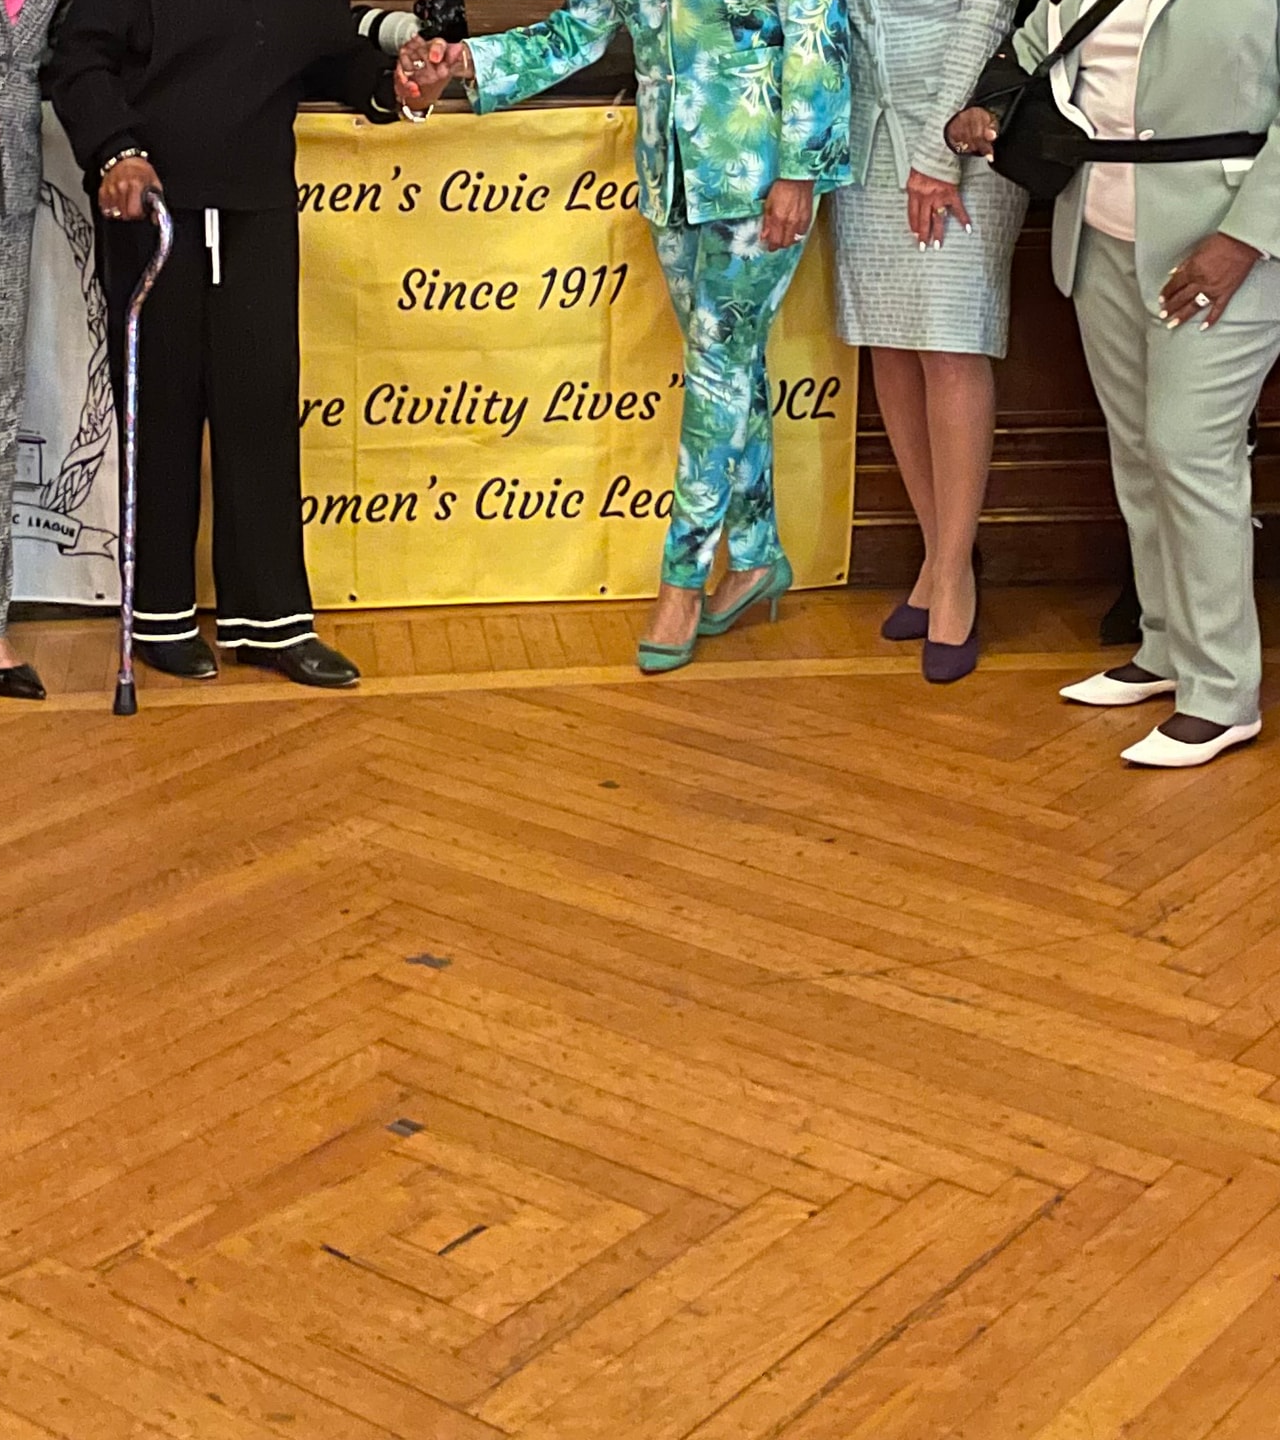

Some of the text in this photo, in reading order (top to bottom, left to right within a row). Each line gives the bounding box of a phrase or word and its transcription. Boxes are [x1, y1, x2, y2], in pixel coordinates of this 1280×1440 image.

[440, 170, 550, 212] Civic
[398, 264, 629, 310] Since 1911
[364, 381, 528, 438] Civility
[475, 477, 584, 520] Civic
